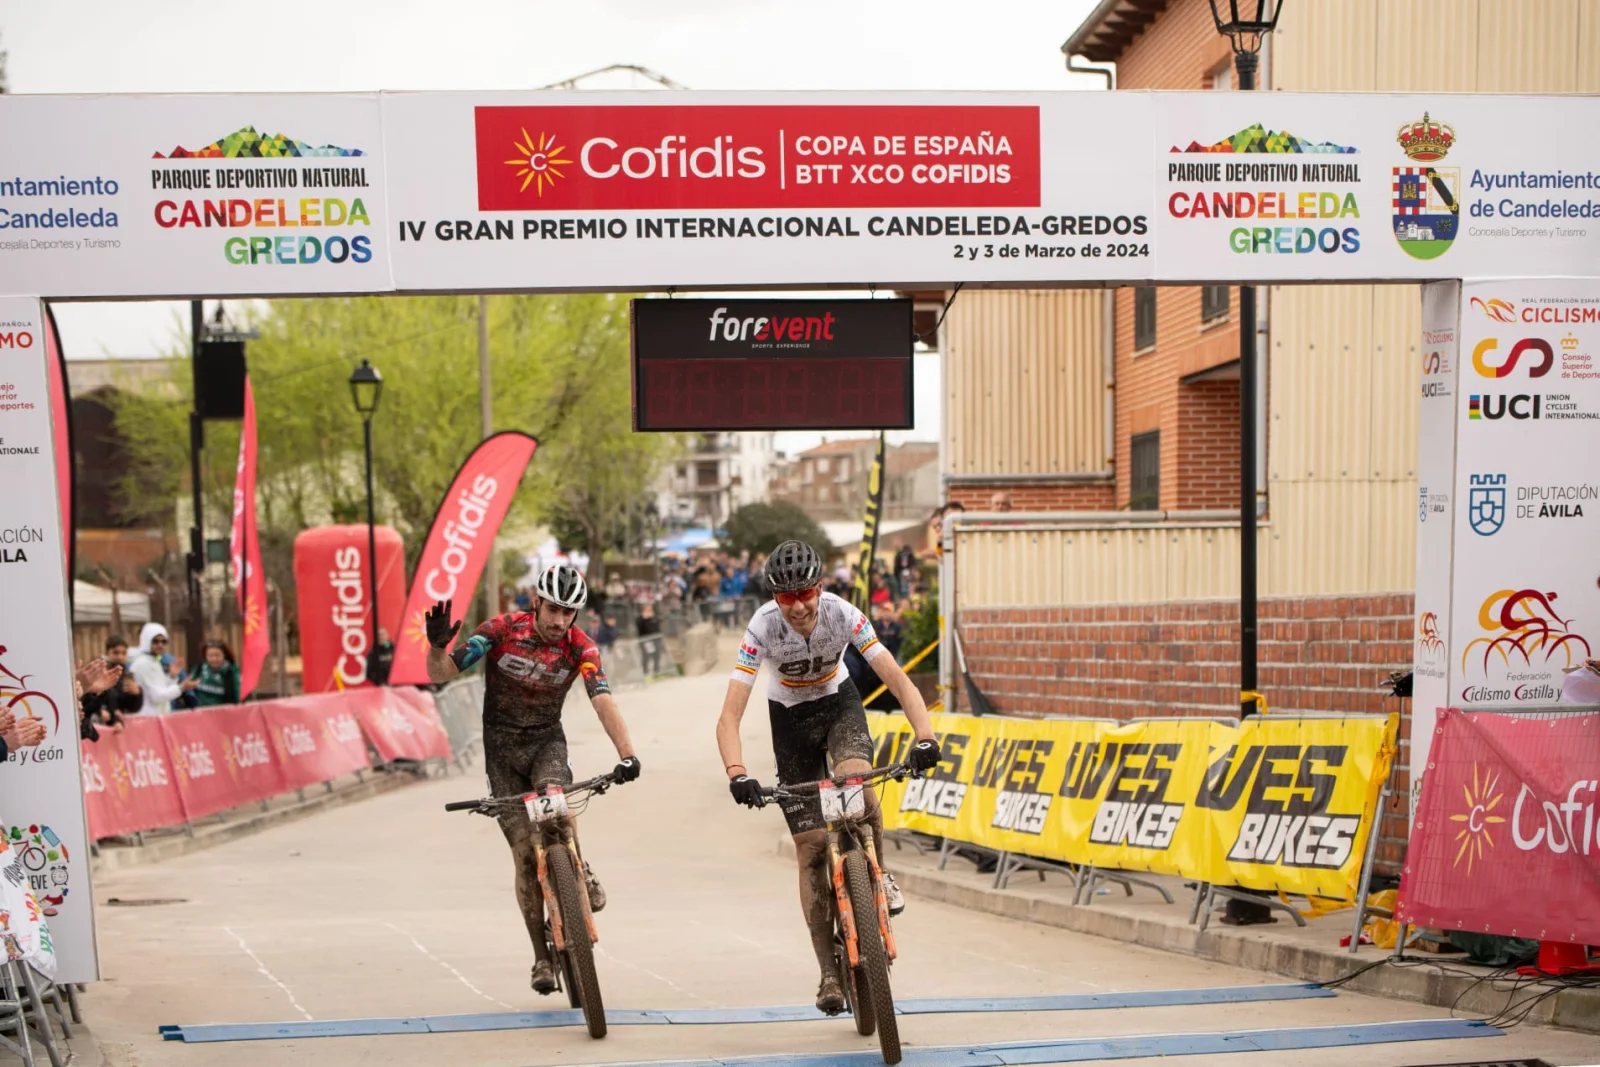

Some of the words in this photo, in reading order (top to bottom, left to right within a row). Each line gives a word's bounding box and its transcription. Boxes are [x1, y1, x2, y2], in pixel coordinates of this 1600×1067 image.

[795, 135, 867, 156] COPA
[873, 136, 907, 156] DE
[914, 131, 1013, 156] ESPAÑA
[580, 135, 766, 179] Cofidis
[151, 168, 211, 191] PARQUE
[216, 168, 298, 189] DEPORTIVO
[795, 164, 843, 185] BTT
[850, 164, 905, 185] XCO
[911, 163, 1012, 184] COFIDIS
[1168, 162, 1221, 183] PARQUE
[1226, 163, 1298, 182] DEPORTIVO
[154, 197, 371, 228] CANDELEDA
[1168, 191, 1361, 219] CANDELEDA
[1470, 199, 1494, 218] de
[1499, 199, 1600, 218] Candeleda
[400, 221, 427, 242] IV
[435, 220, 514, 241] GRAN
[523, 219, 627, 240] PREMIO
[637, 217, 860, 239] INTERNACIONAL
[868, 215, 1148, 236] CANDELEDA-GREDOS
[1511, 227, 1548, 238] Deportes
[1549, 229, 1555, 239] y
[1556, 227, 1587, 237] Turismo
[30, 239, 74, 251] Deportes
[75, 241, 82, 252] y
[83, 238, 121, 249] Turismo
[224, 235, 372, 265] GREDOS
[1229, 227, 1361, 254] GREDOS
[953, 245, 964, 259] 2
[968, 248, 979, 261] y
[984, 245, 994, 259] 3
[999, 243, 1020, 258] de
[1025, 243, 1076, 258] Marzo
[1080, 243, 1101, 258] de
[1106, 243, 1150, 258] 2024
[0, 320, 32, 328] PAÑOLA
[709, 307, 837, 342] forevent
[1521, 307, 1600, 323] CICLISM
[1562, 353, 1592, 363] Consejo
[1562, 362, 1593, 371] Superior
[1561, 371, 1571, 379] de
[0, 382, 15, 394] ejo
[1483, 394, 1541, 420] UCI
[1545, 403, 1578, 411] CYCLISTE
[1517, 484, 1599, 501] DIPUTACIÓN
[1517, 505, 1535, 519] DE
[1538, 502, 1584, 518] ÁVILA
[0, 525, 43, 544] CIÓN
[425, 473, 498, 601] Cofidis
[329, 546, 368, 685] Cofidis
[1506, 672, 1552, 681] Federación
[1462, 685, 1511, 703] Ciclismo
[1514, 684, 1554, 701] Castilla
[1555, 687, 1563, 702] y
[540, 797, 554, 815] 2
[836, 791, 848, 813] 1
[1088, 800, 1186, 851] BIKES
[1512, 779, 1600, 856] Cofi
[1226, 813, 1362, 870] BIKES
